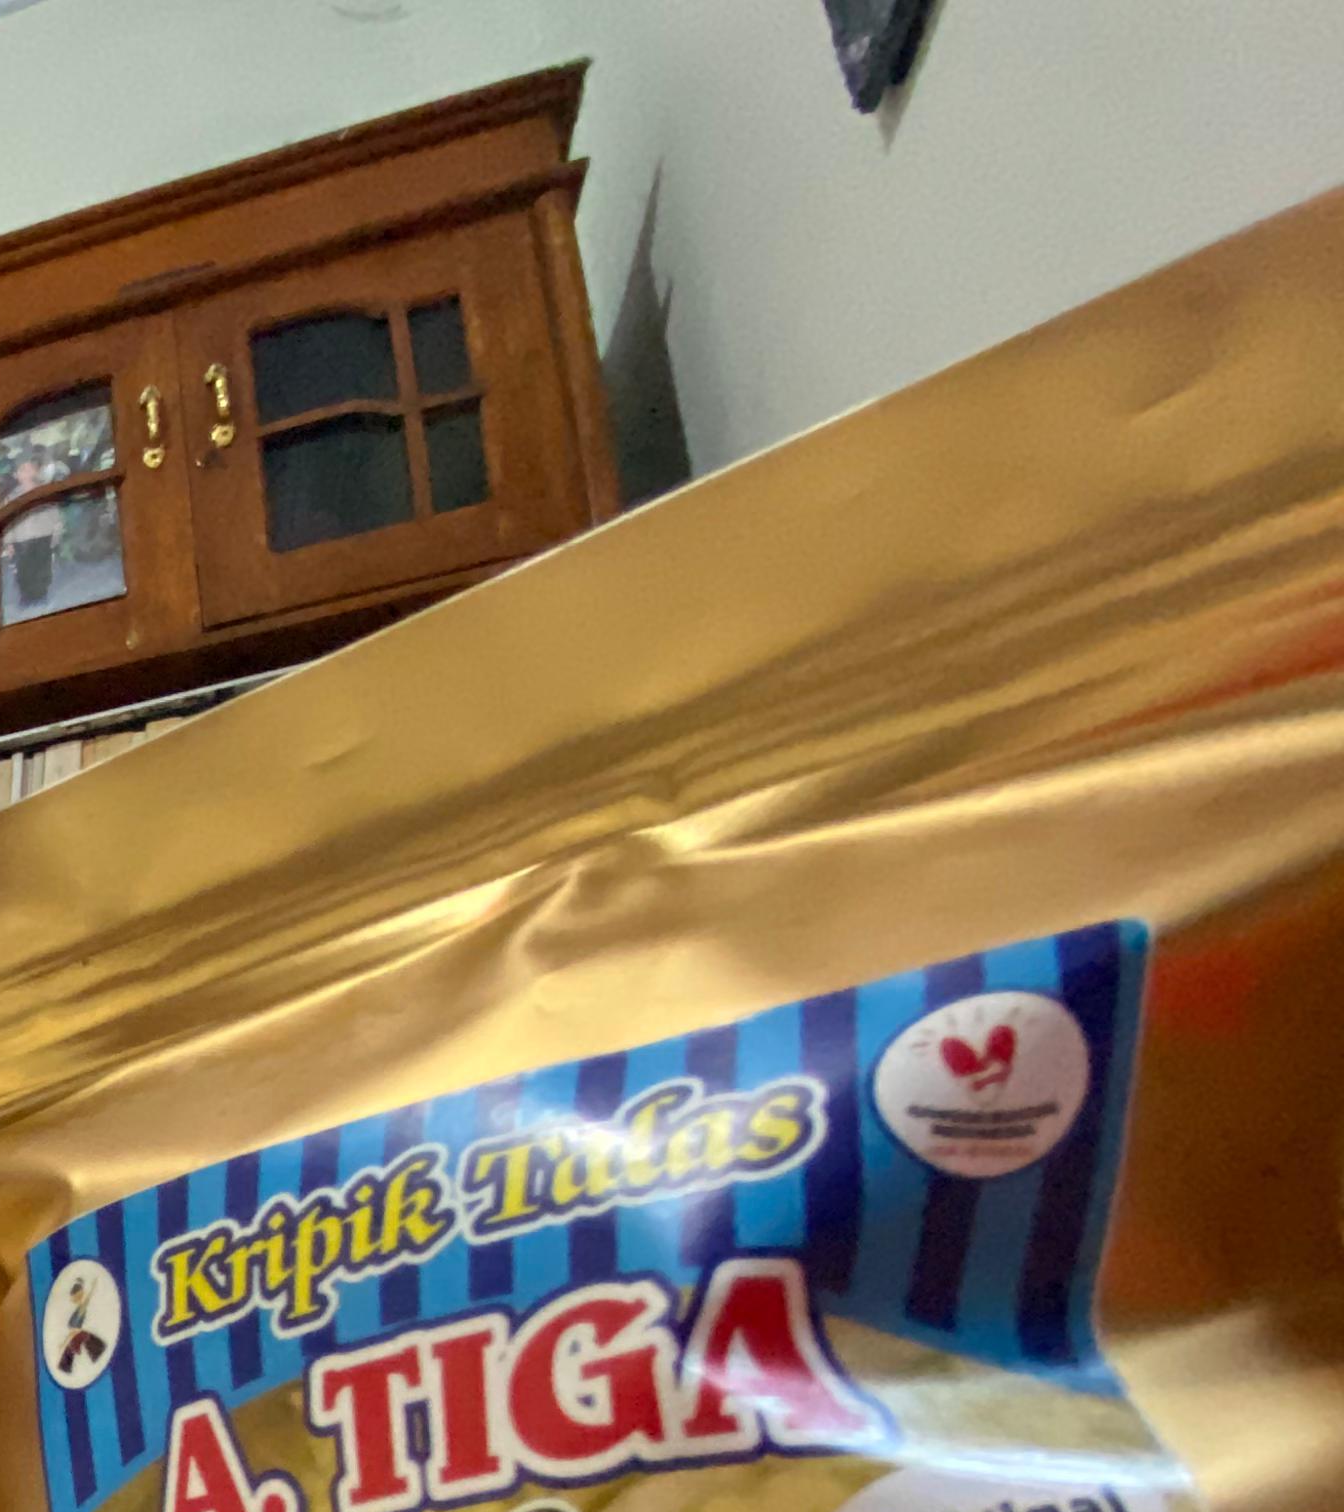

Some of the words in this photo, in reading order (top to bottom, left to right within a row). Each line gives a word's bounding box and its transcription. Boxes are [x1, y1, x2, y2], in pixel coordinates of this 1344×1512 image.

[160, 1152, 448, 1324] Kripik
[468, 1088, 815, 1232] Talas
[321, 1275, 865, 1504] TIGA
